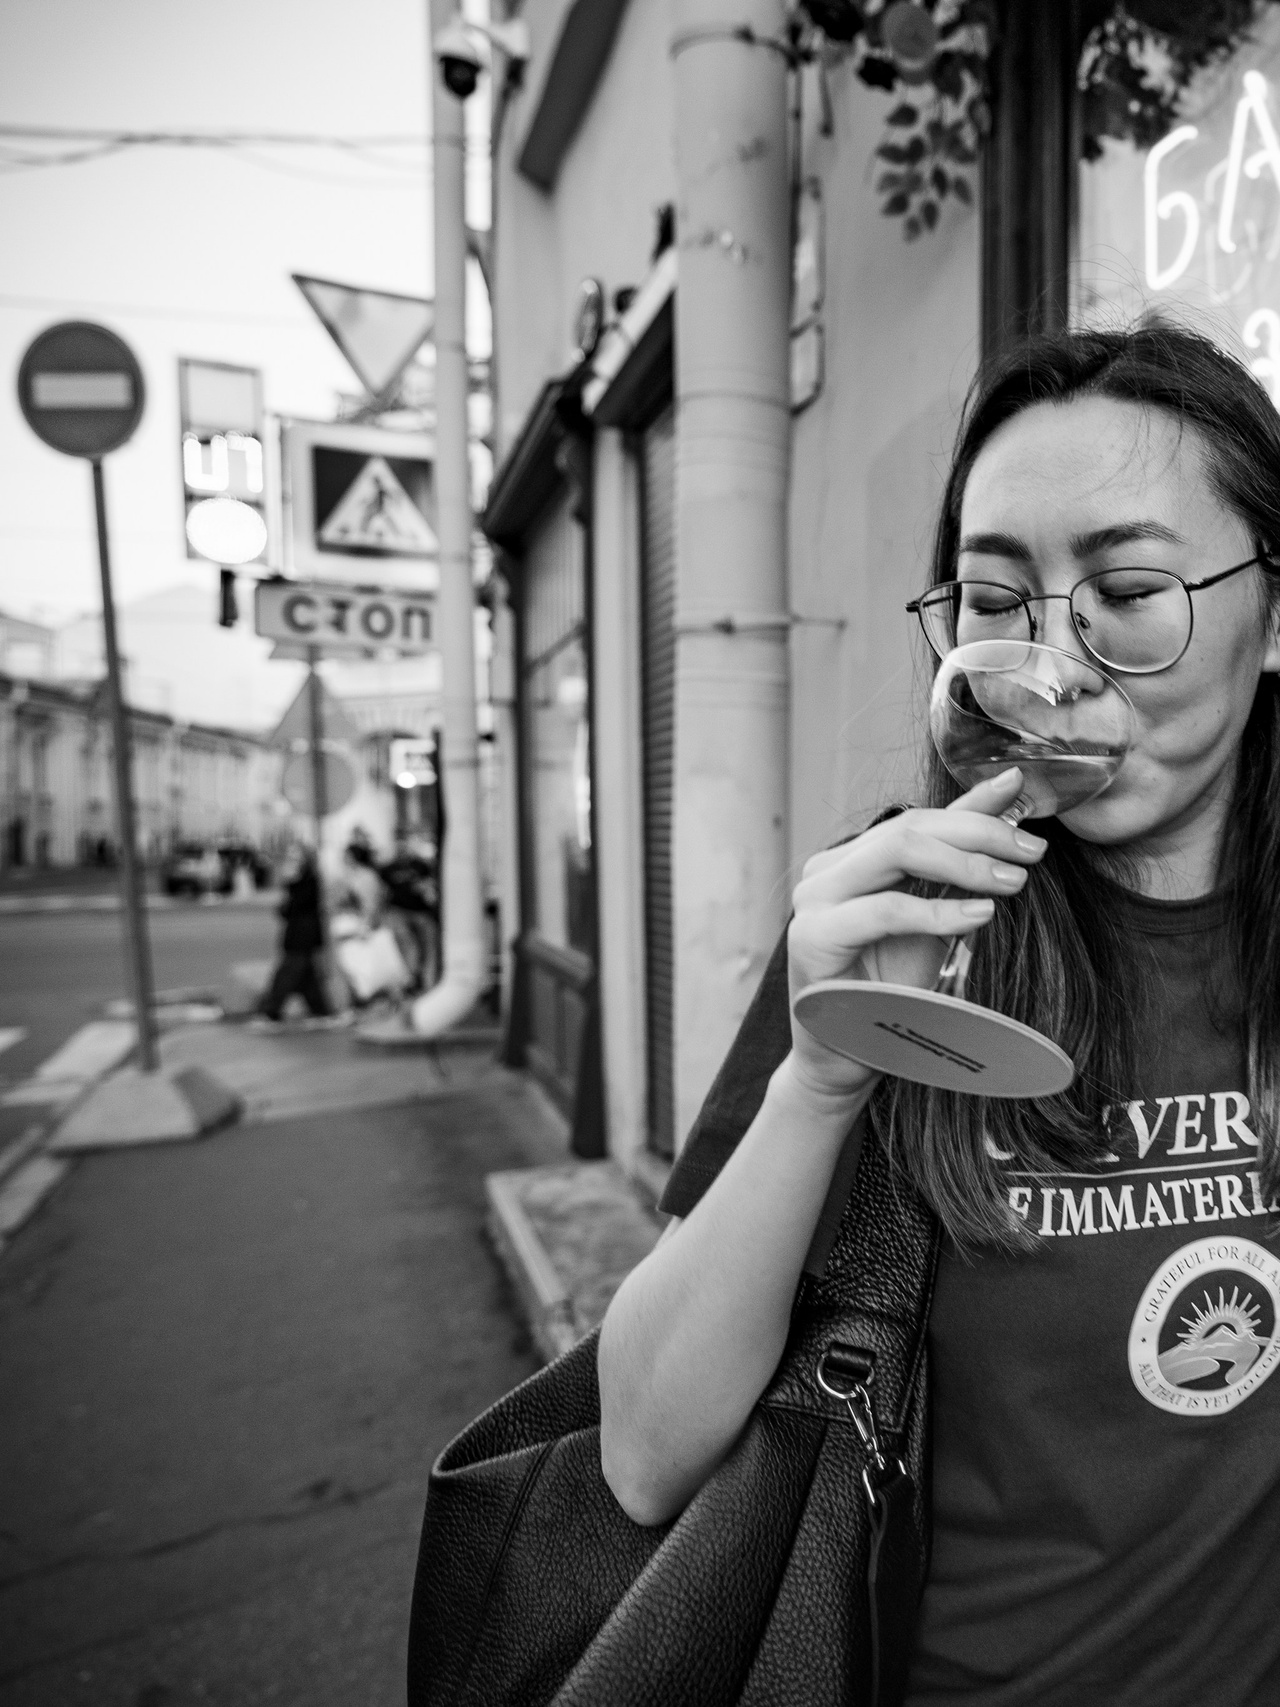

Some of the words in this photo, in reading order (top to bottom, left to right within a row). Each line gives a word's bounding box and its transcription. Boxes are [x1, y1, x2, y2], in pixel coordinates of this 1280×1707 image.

[1144, 1251, 1205, 1323] GRATEFUL
[1207, 1245, 1239, 1260] FOR
[1242, 1250, 1266, 1273] ALL
[1138, 1362, 1157, 1388] ALL
[1151, 1383, 1186, 1406] THAT
[1203, 1391, 1231, 1408] YET
[1236, 1379, 1253, 1396] TO
